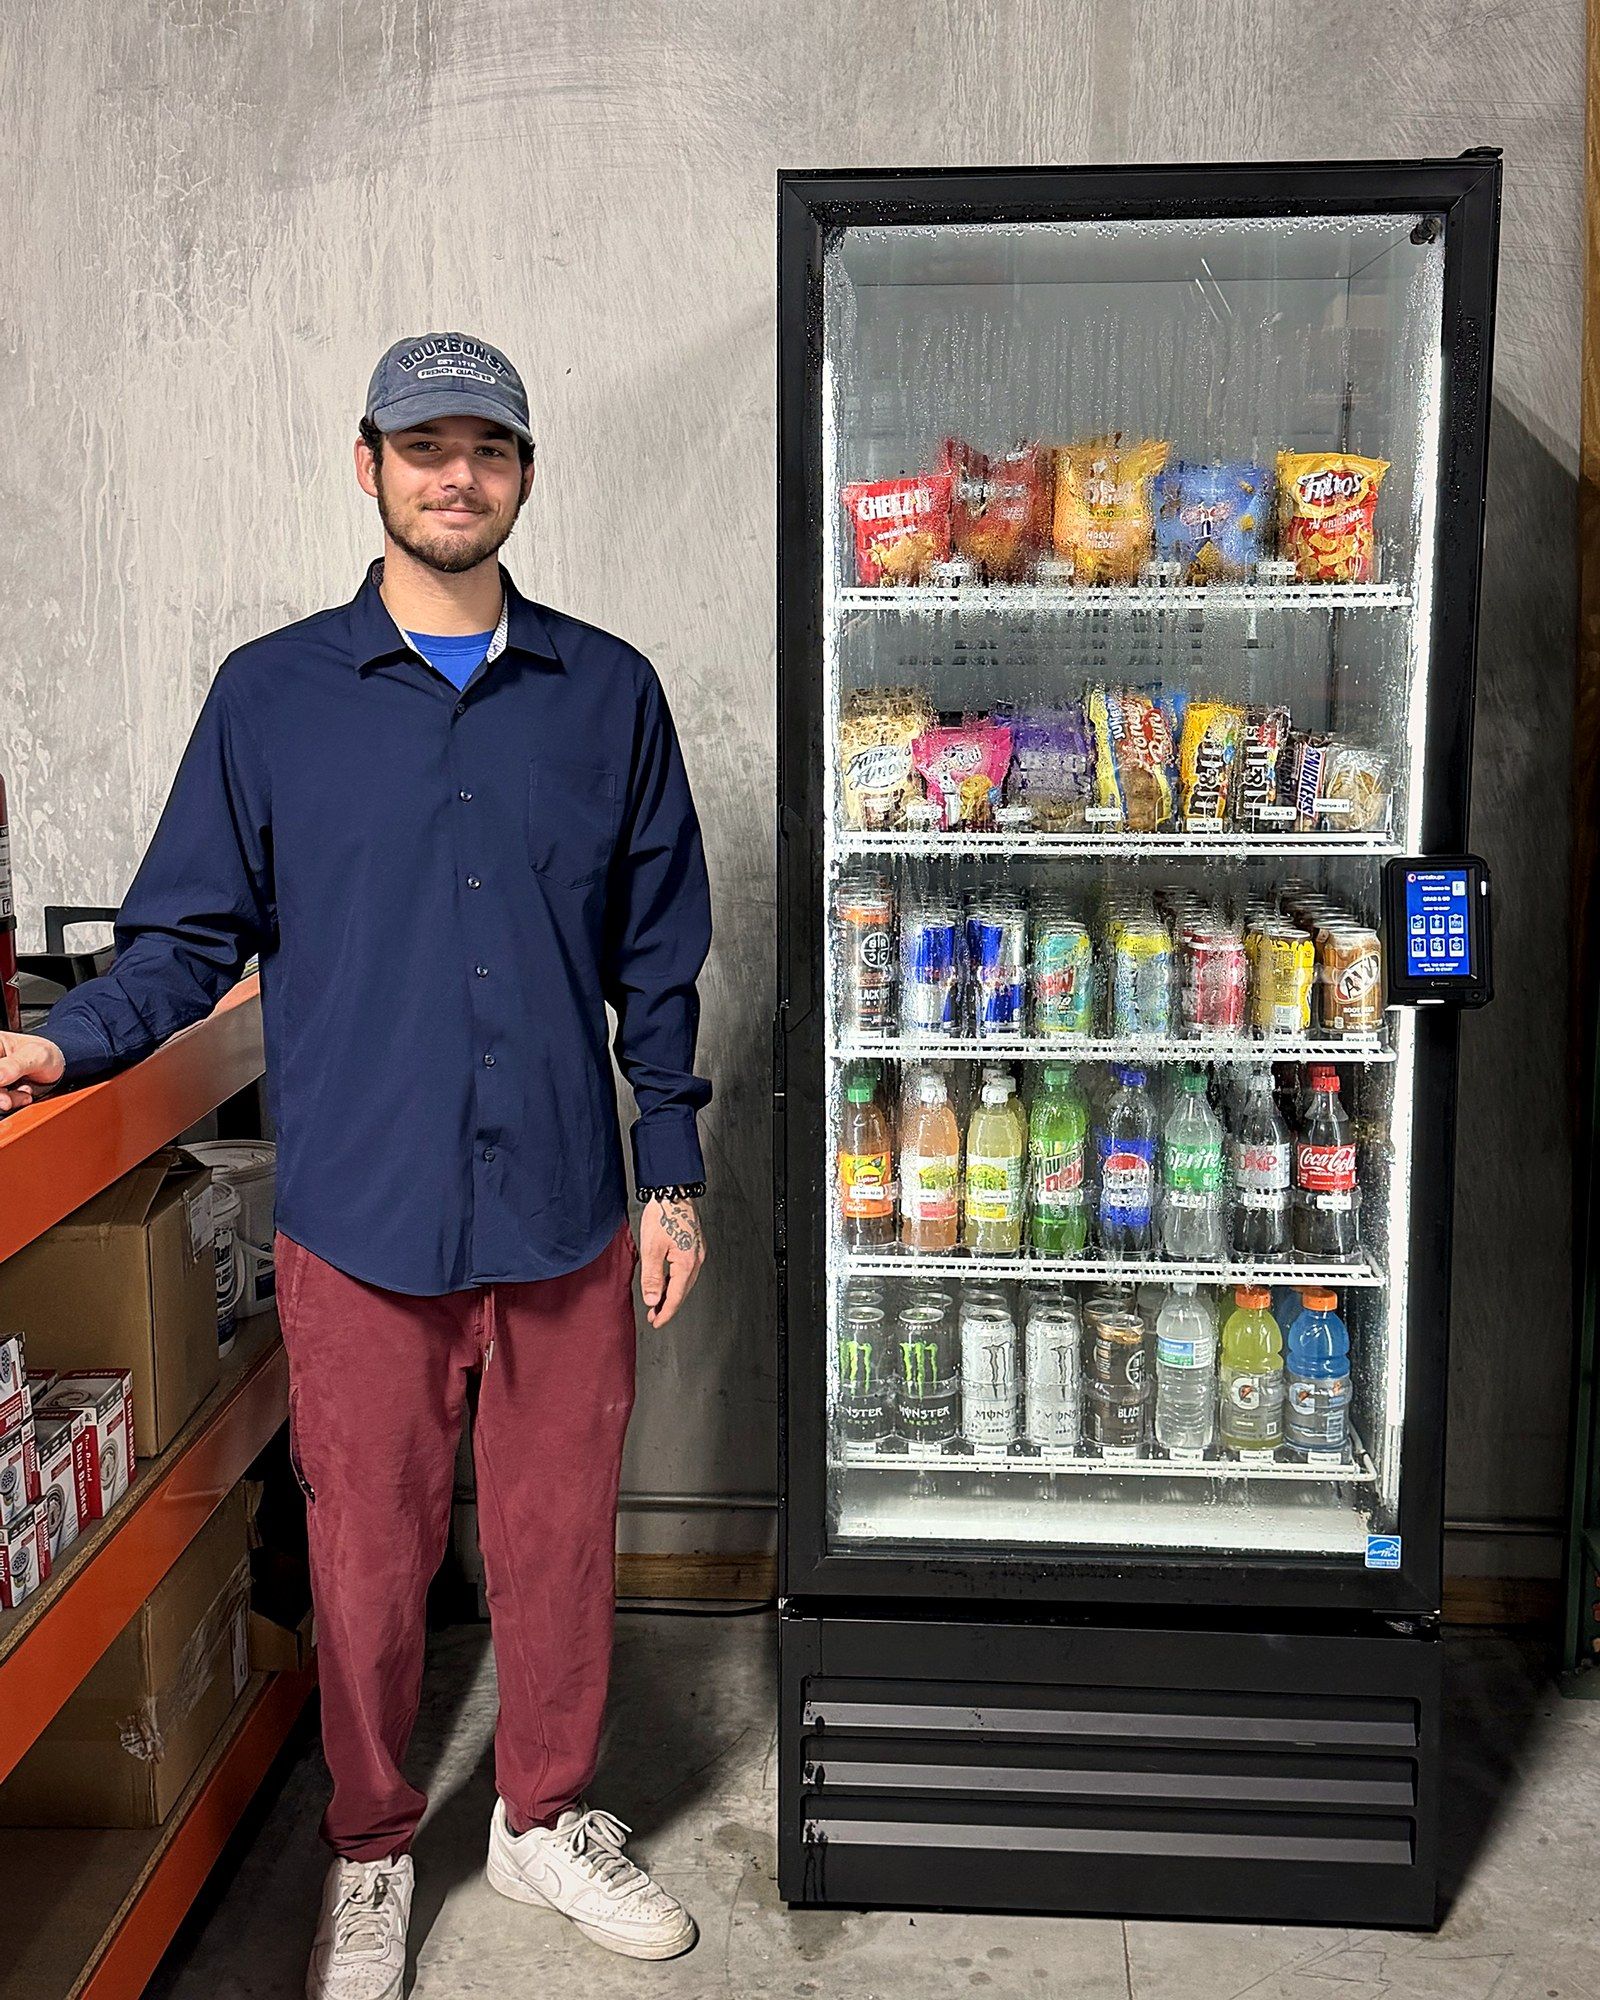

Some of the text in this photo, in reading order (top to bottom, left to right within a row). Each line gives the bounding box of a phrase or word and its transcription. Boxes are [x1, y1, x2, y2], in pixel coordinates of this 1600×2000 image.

[397, 339, 510, 376] BOURBON ST
[421, 367, 492, 382] FRENCH QUARTER
[1298, 744, 1322, 815] SNICKERS
[899, 1405, 950, 1419] MONSTER
[128, 1426, 136, 1472] Basket
[76, 1441, 89, 1518] Duo Basket
